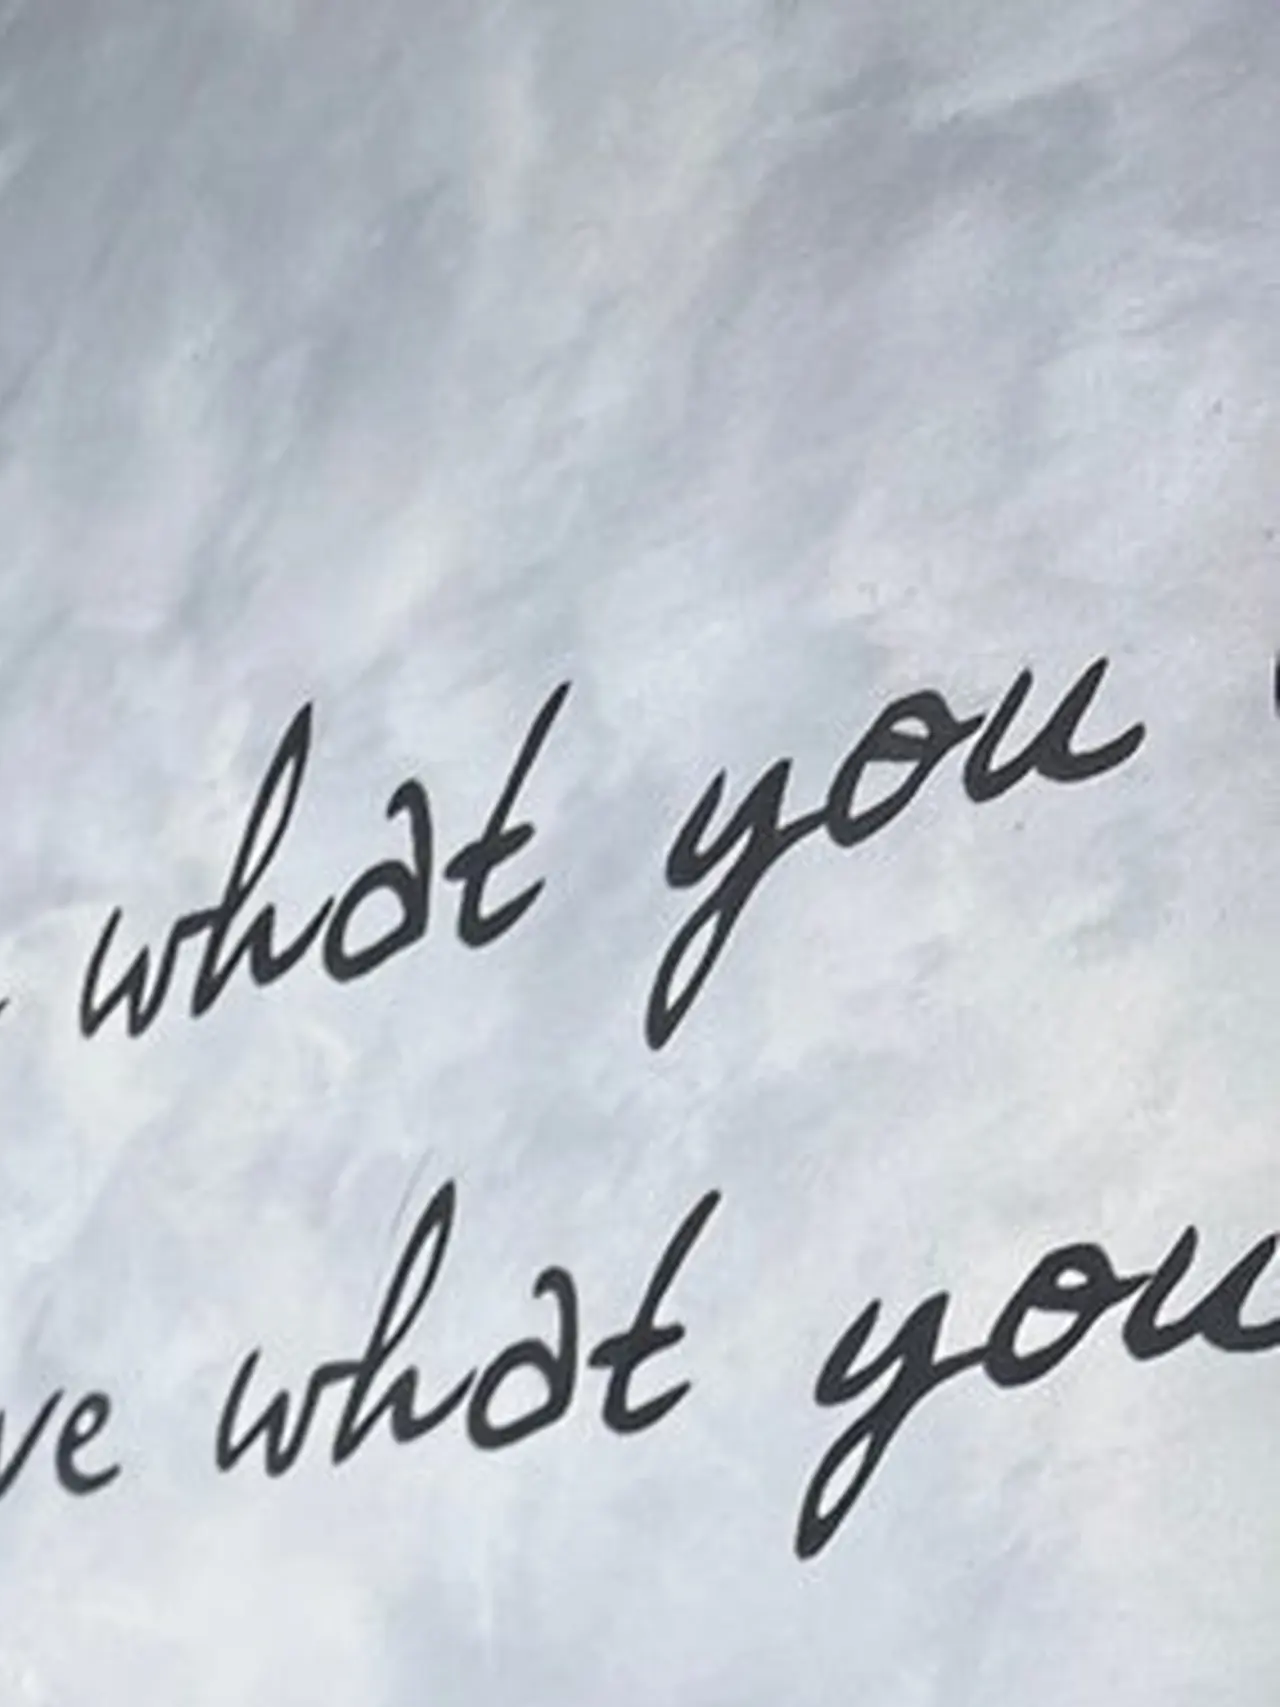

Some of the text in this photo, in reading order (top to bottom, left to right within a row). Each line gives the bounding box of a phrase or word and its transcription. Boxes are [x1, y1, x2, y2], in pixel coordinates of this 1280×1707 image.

[79, 680, 572, 1038] what
[644, 657, 1147, 1051] you
[215, 1179, 722, 1478] what
[794, 1224, 1280, 1561] you
